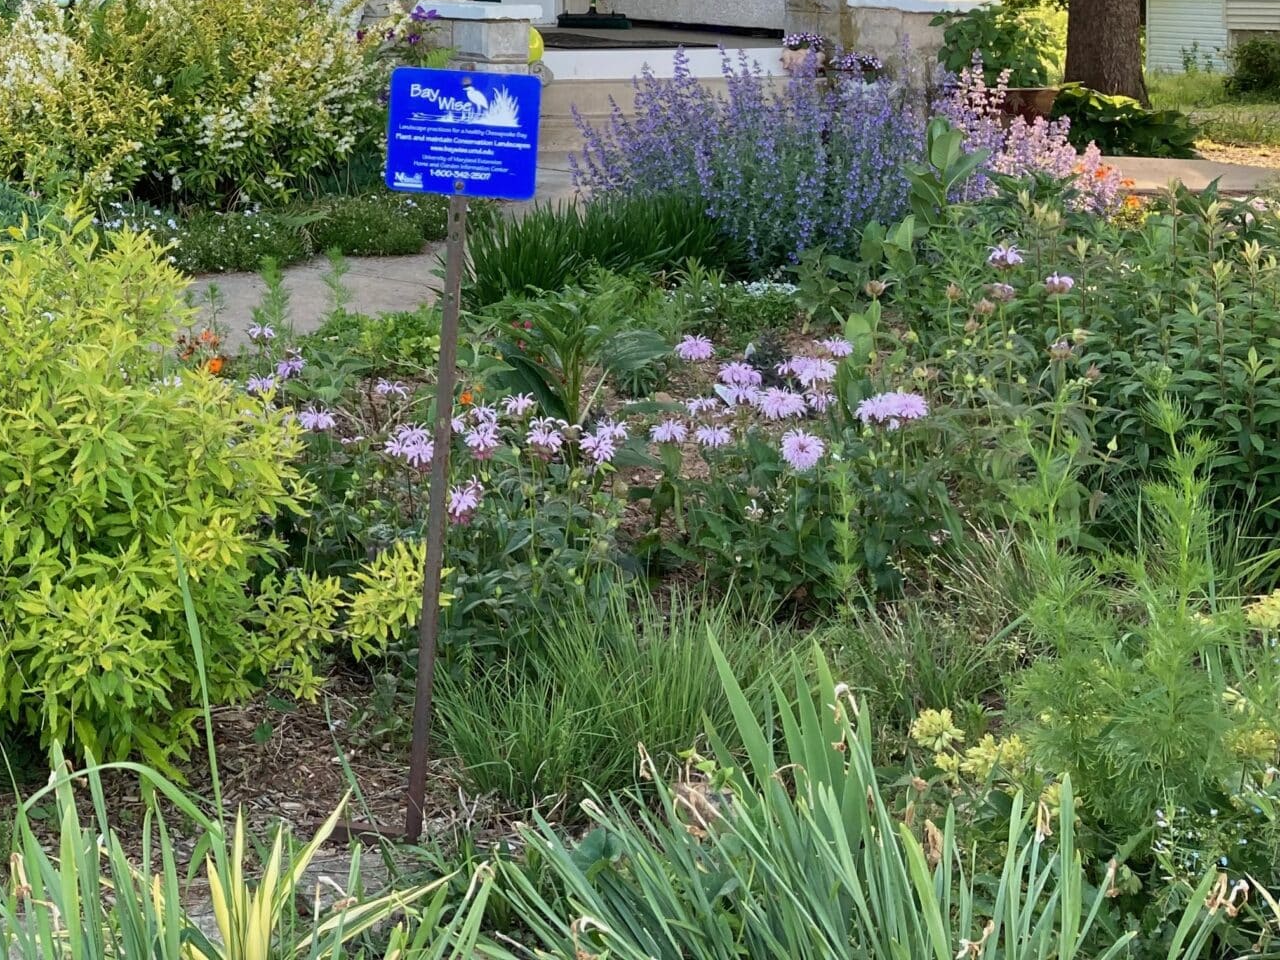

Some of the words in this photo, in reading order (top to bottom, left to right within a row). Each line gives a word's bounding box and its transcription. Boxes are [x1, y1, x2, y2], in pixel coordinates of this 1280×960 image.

[410, 83, 440, 102] Bay
[438, 96, 473, 112] Wise
[399, 123, 427, 132] Landscape
[464, 128, 485, 137] healthy
[516, 131, 528, 140] Bay
[425, 135, 453, 143] maintain
[453, 137, 493, 146] Conservation
[493, 139, 532, 151] Landscapes
[422, 154, 447, 162] University
[453, 156, 477, 164] Maryland
[477, 157, 503, 165] Extension
[460, 163, 490, 171] Information
[490, 165, 510, 173] Center
